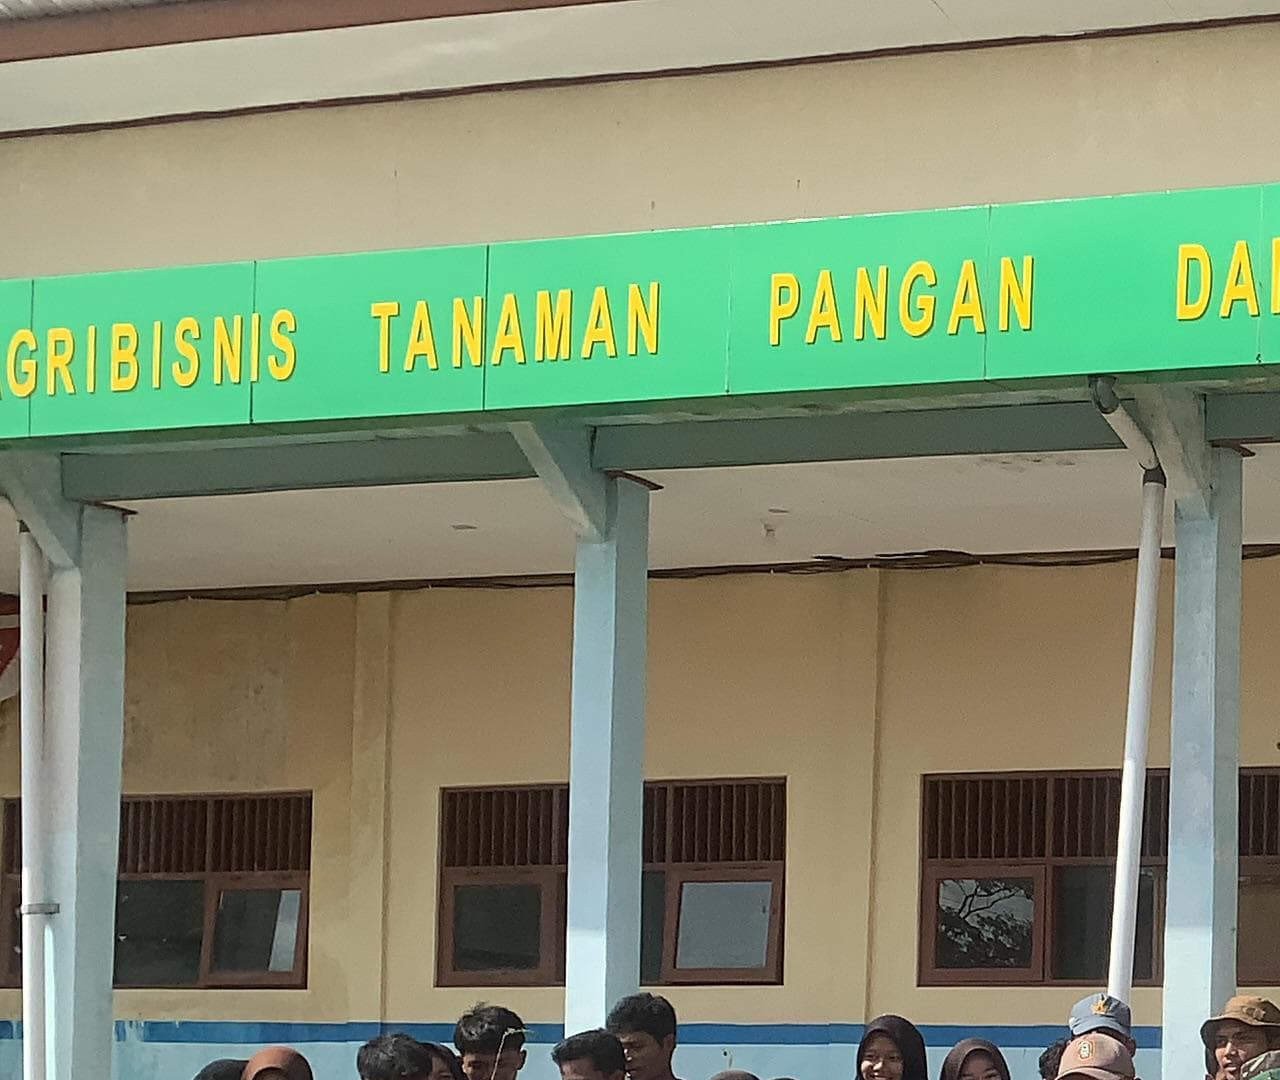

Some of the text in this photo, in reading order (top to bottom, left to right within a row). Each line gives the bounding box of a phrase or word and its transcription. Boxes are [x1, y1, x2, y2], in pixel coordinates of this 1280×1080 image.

[0, 309, 298, 399] GRIBISNIS
[370, 281, 661, 374] TANAMAN
[768, 255, 1036, 346] PANGAN
